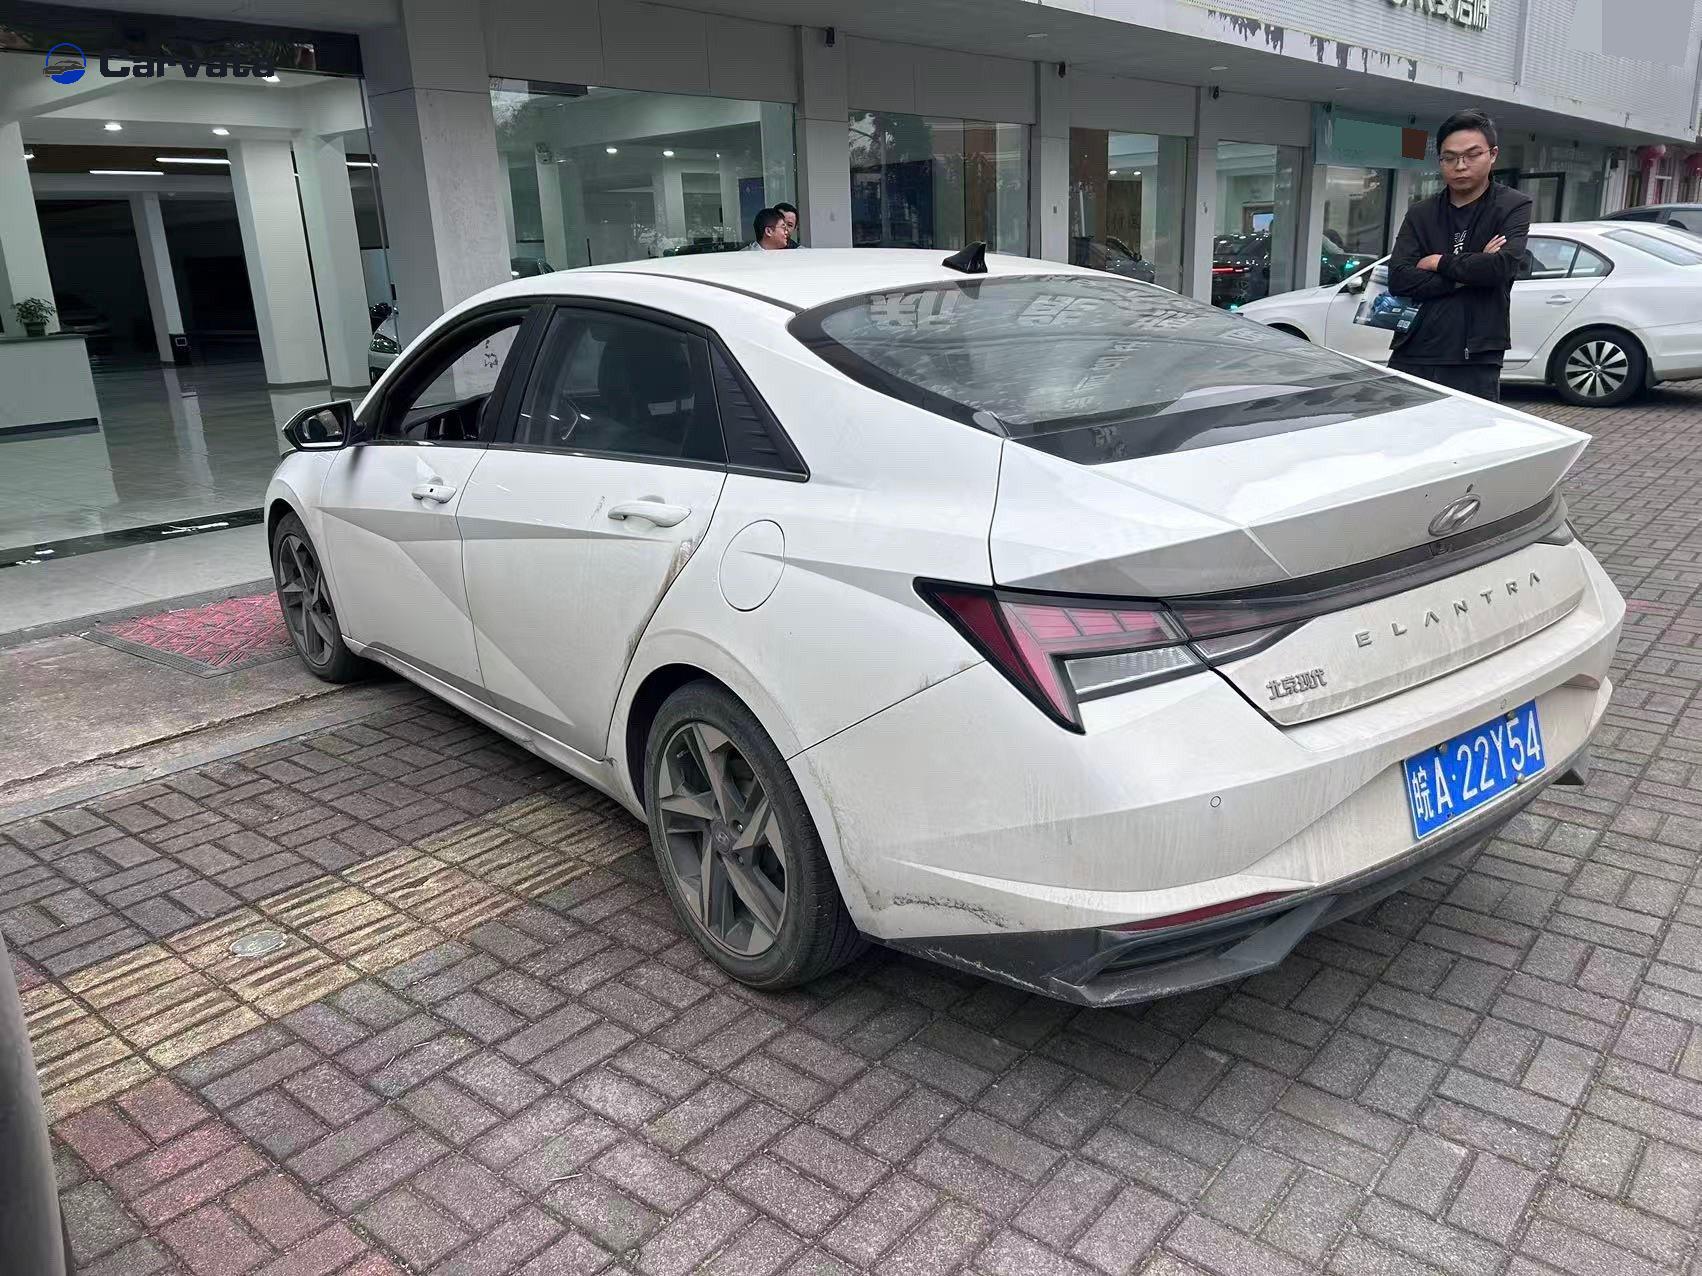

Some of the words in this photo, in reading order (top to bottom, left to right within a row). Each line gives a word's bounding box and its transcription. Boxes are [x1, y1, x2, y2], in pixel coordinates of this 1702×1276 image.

[1355, 572, 1541, 647] ELANTRA
[1266, 669, 1327, 700] 北京现代
